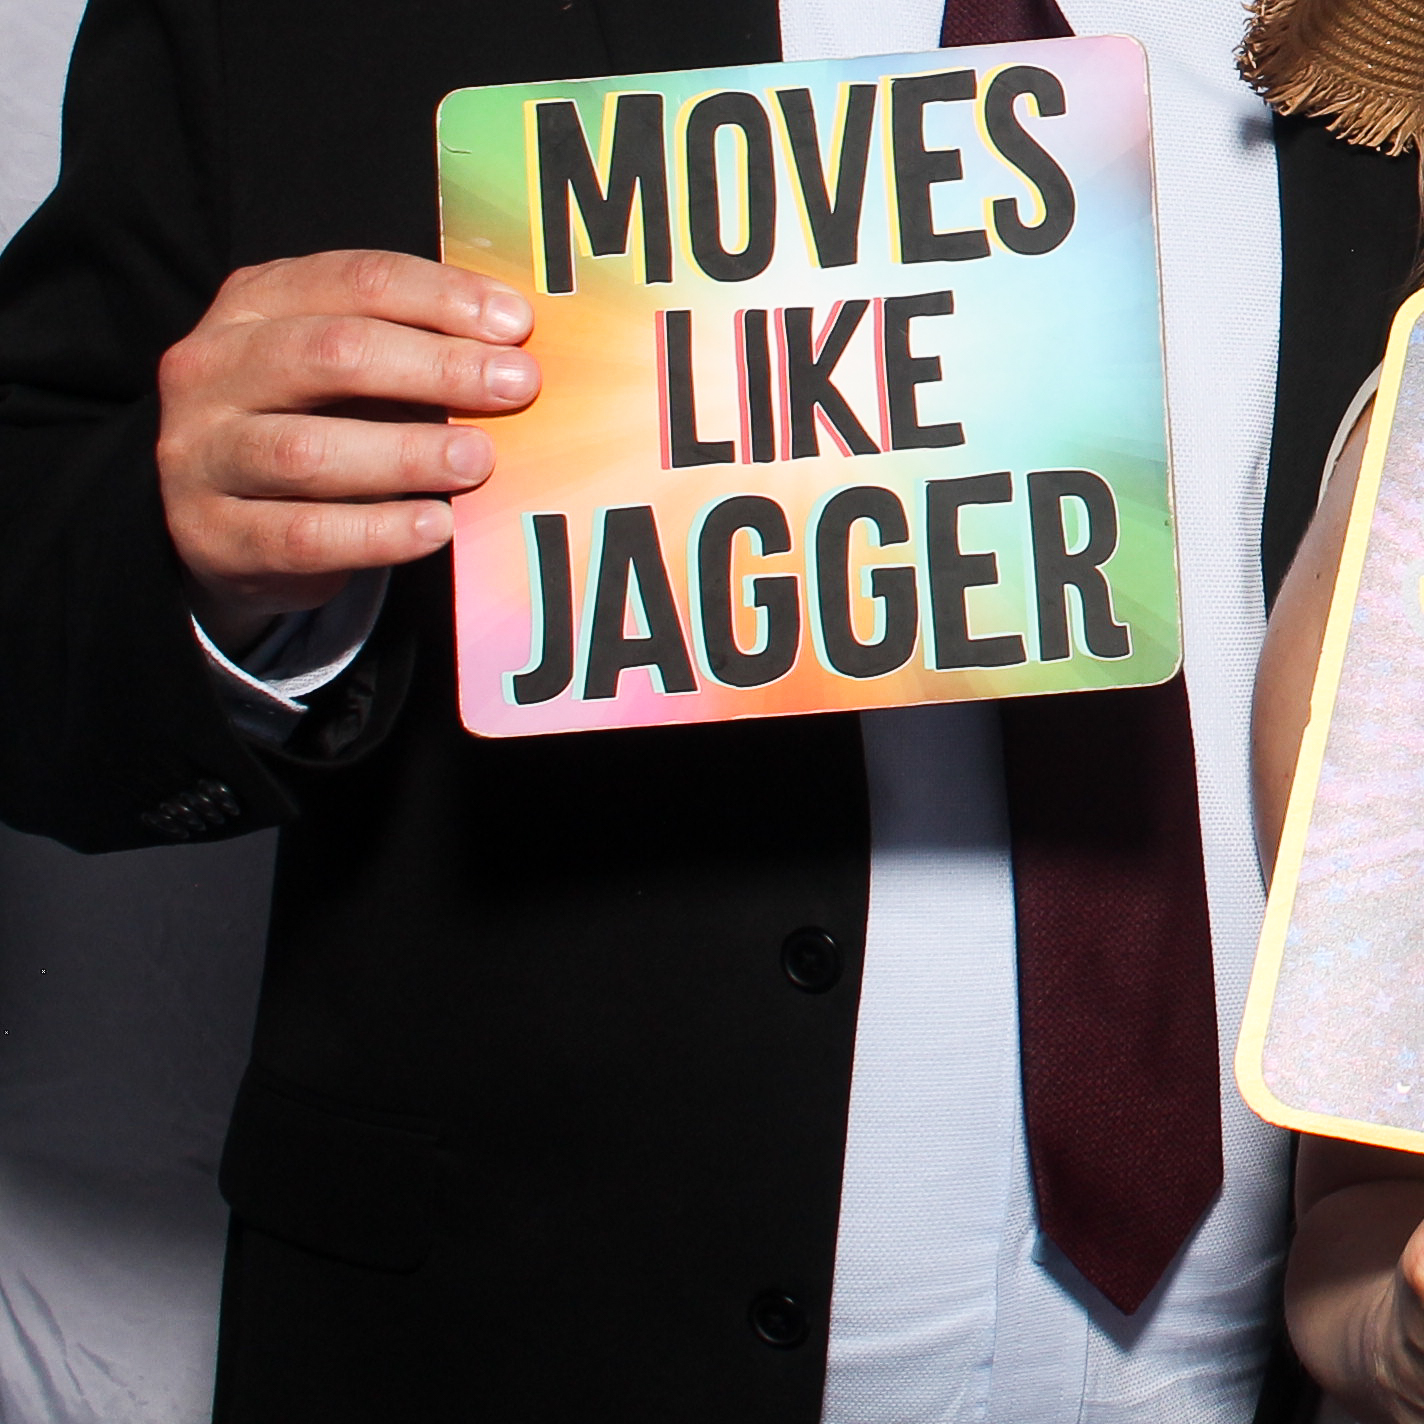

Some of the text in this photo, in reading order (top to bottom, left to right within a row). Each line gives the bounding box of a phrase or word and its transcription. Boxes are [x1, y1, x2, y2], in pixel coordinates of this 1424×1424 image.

[524, 63, 1077, 295] MOVES
[655, 290, 967, 469] LIKE
[502, 469, 1133, 706] JAGGER
